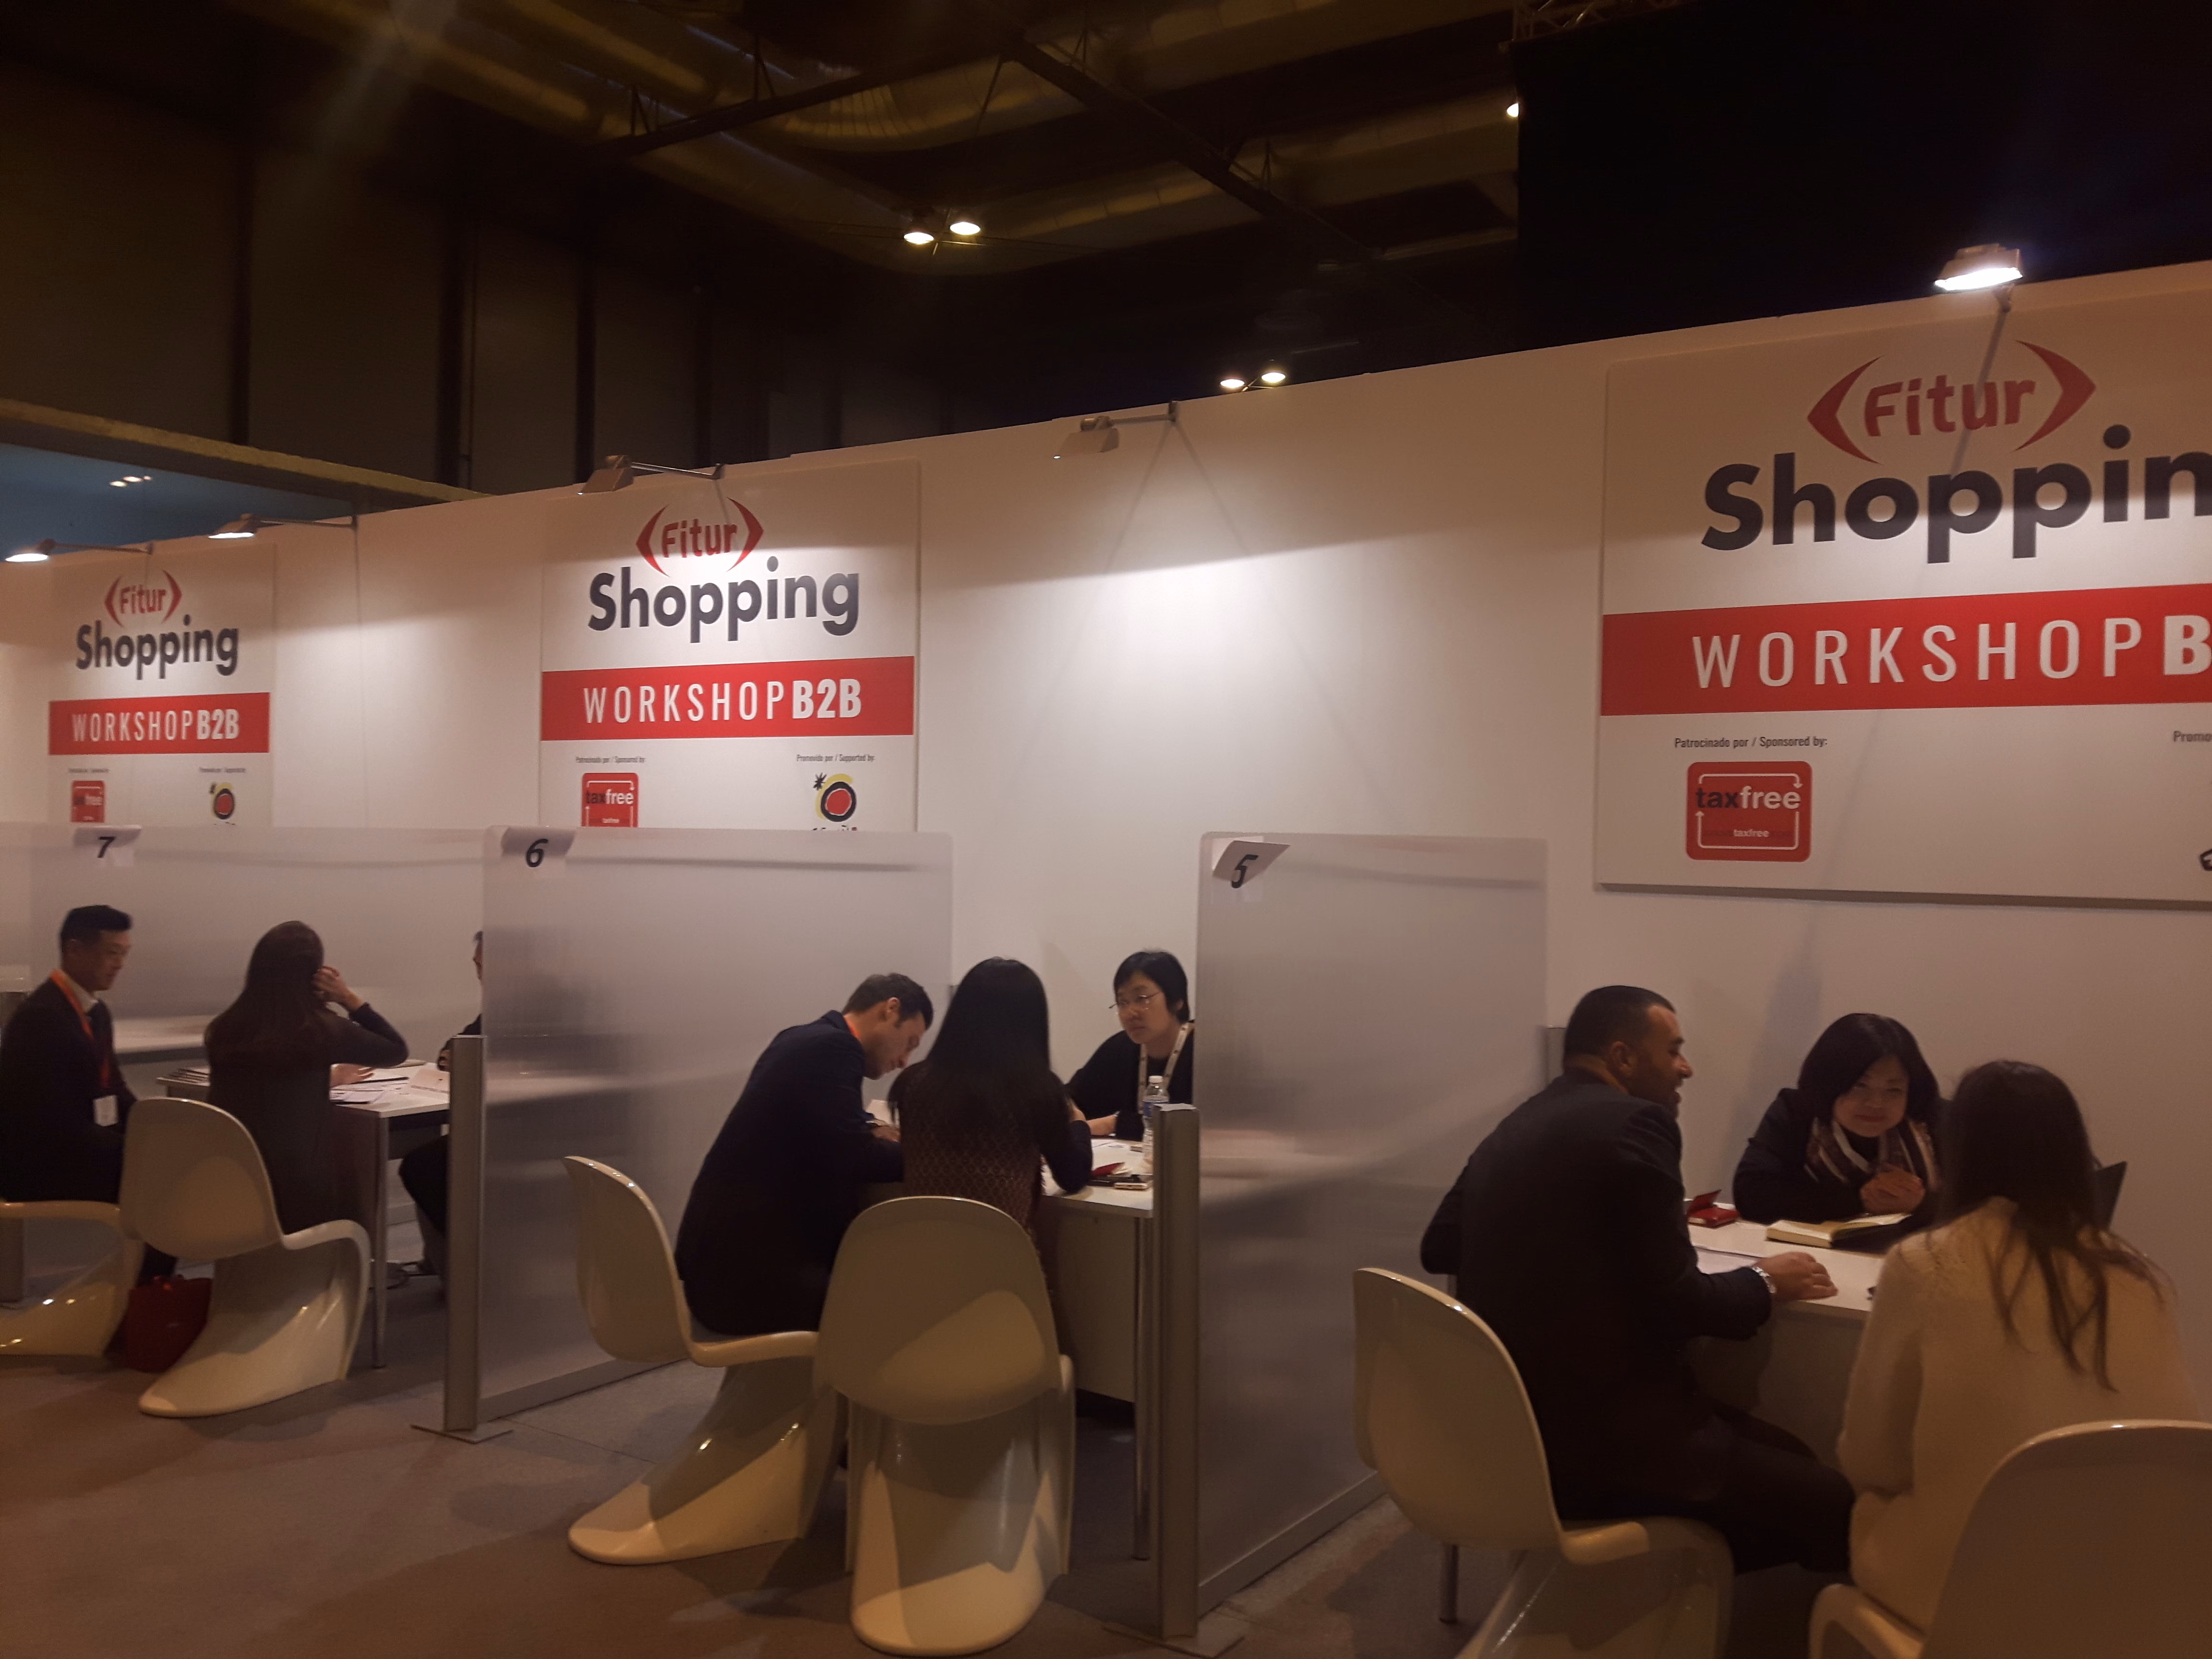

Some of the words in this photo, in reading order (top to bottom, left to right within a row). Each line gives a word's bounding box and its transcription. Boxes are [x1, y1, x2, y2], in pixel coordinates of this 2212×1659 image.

[1863, 375, 2036, 437] Fitur
[1701, 424, 2212, 564] Shoppin
[661, 518, 738, 559] Fitur
[120, 584, 167, 614] Fitur
[588, 556, 861, 644] Shopping
[75, 614, 239, 681] Shopping
[1692, 617, 2142, 689] WORKSHOP
[583, 681, 784, 723] WORKSHOP
[792, 678, 862, 720] B2B
[73, 709, 193, 742] WORKSHOP
[197, 709, 240, 740] B2B
[1675, 738, 1730, 748] Patrocinado
[1733, 739, 1749, 749] por
[1759, 736, 1810, 748] Sponsored
[1695, 785, 1801, 810] taxfree
[97, 836, 116, 858] 7
[526, 838, 548, 868] 6
[1231, 854, 1259, 889] 5
